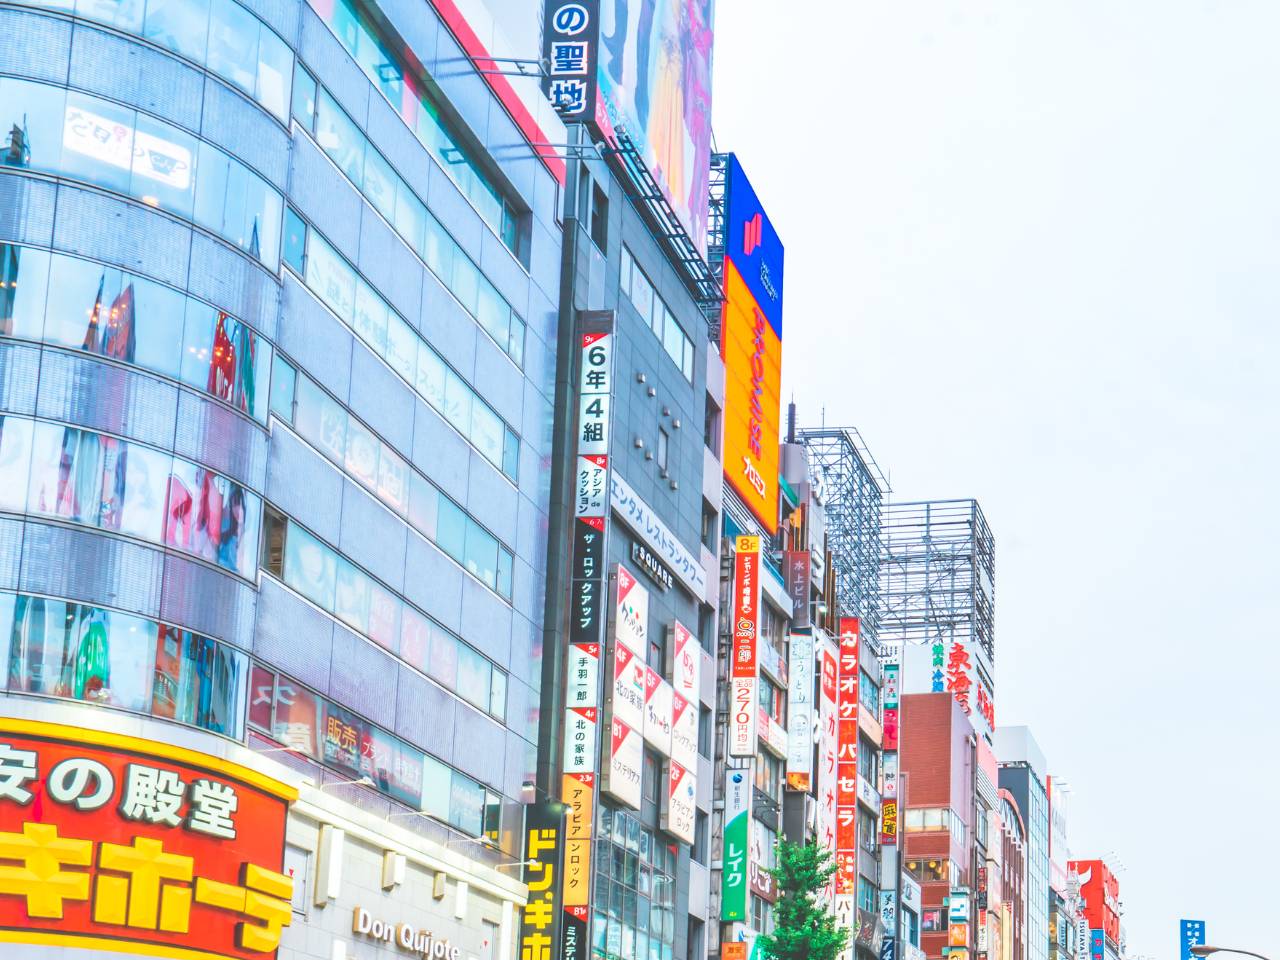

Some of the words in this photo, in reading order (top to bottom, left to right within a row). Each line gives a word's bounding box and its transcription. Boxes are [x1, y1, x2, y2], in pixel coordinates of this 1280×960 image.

[551, 3, 589, 114] の聖地
[740, 539, 756, 550] 8F
[639, 547, 673, 588] SQUARE
[793, 561, 804, 608] 水上ビル
[577, 657, 589, 701] 手羽一郎
[736, 679, 752, 687] 全品
[839, 631, 857, 717] カラオケ
[328, 717, 358, 751] 販売
[574, 719, 586, 766] 北の家族
[838, 743, 857, 827] パセラ
[727, 843, 742, 887] レイク
[358, 907, 394, 942] Don
